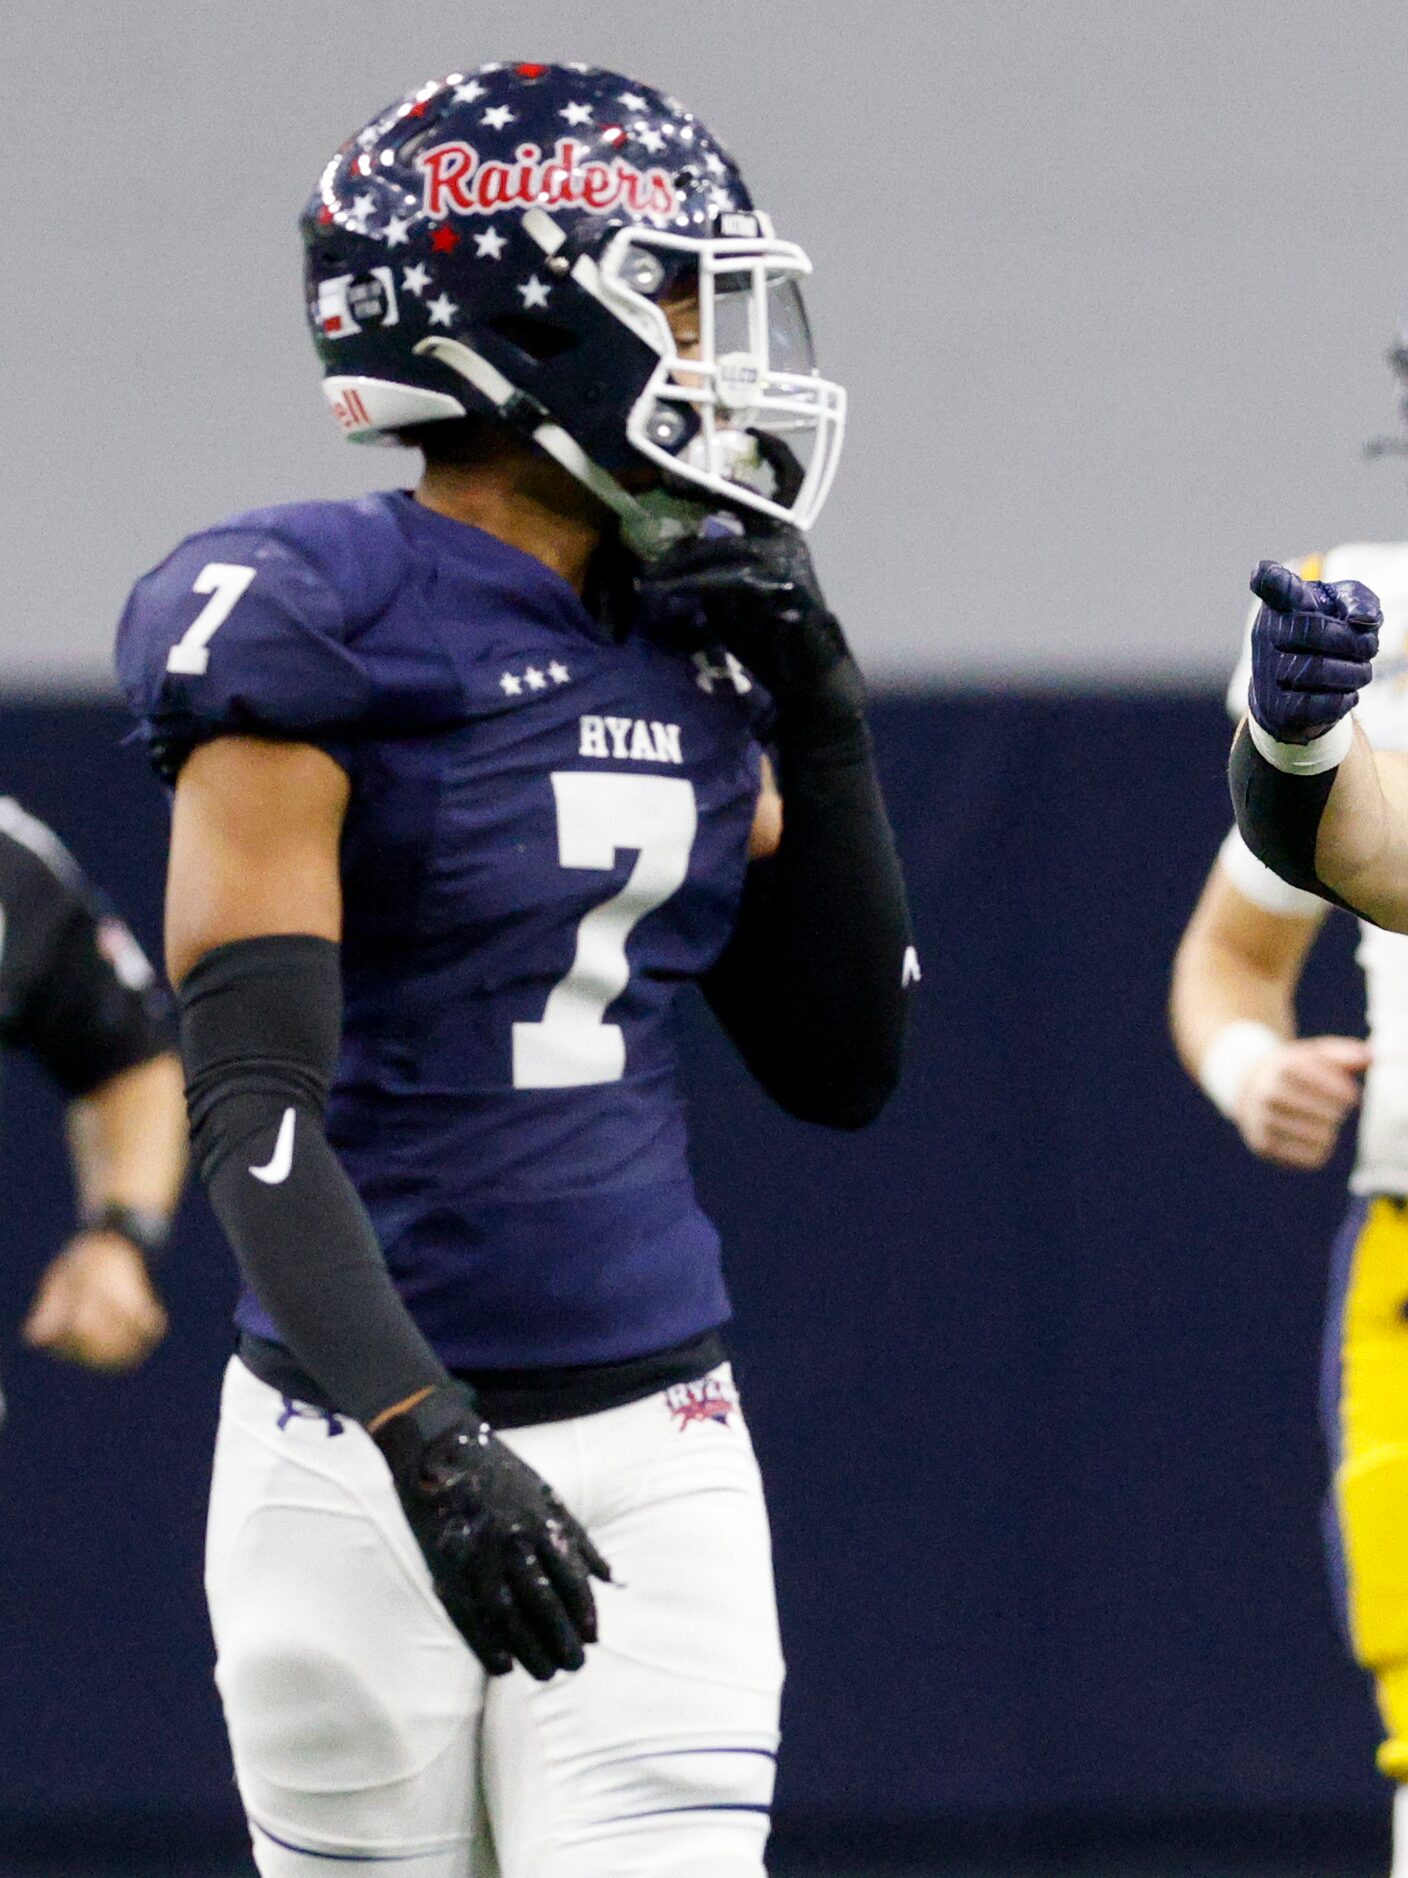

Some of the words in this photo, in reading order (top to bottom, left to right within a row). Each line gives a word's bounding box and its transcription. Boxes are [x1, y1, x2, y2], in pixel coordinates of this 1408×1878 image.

[415, 138, 681, 219] Raiders
[166, 563, 257, 675] 7
[579, 714, 684, 764] RYAN
[512, 771, 697, 1090] 7
